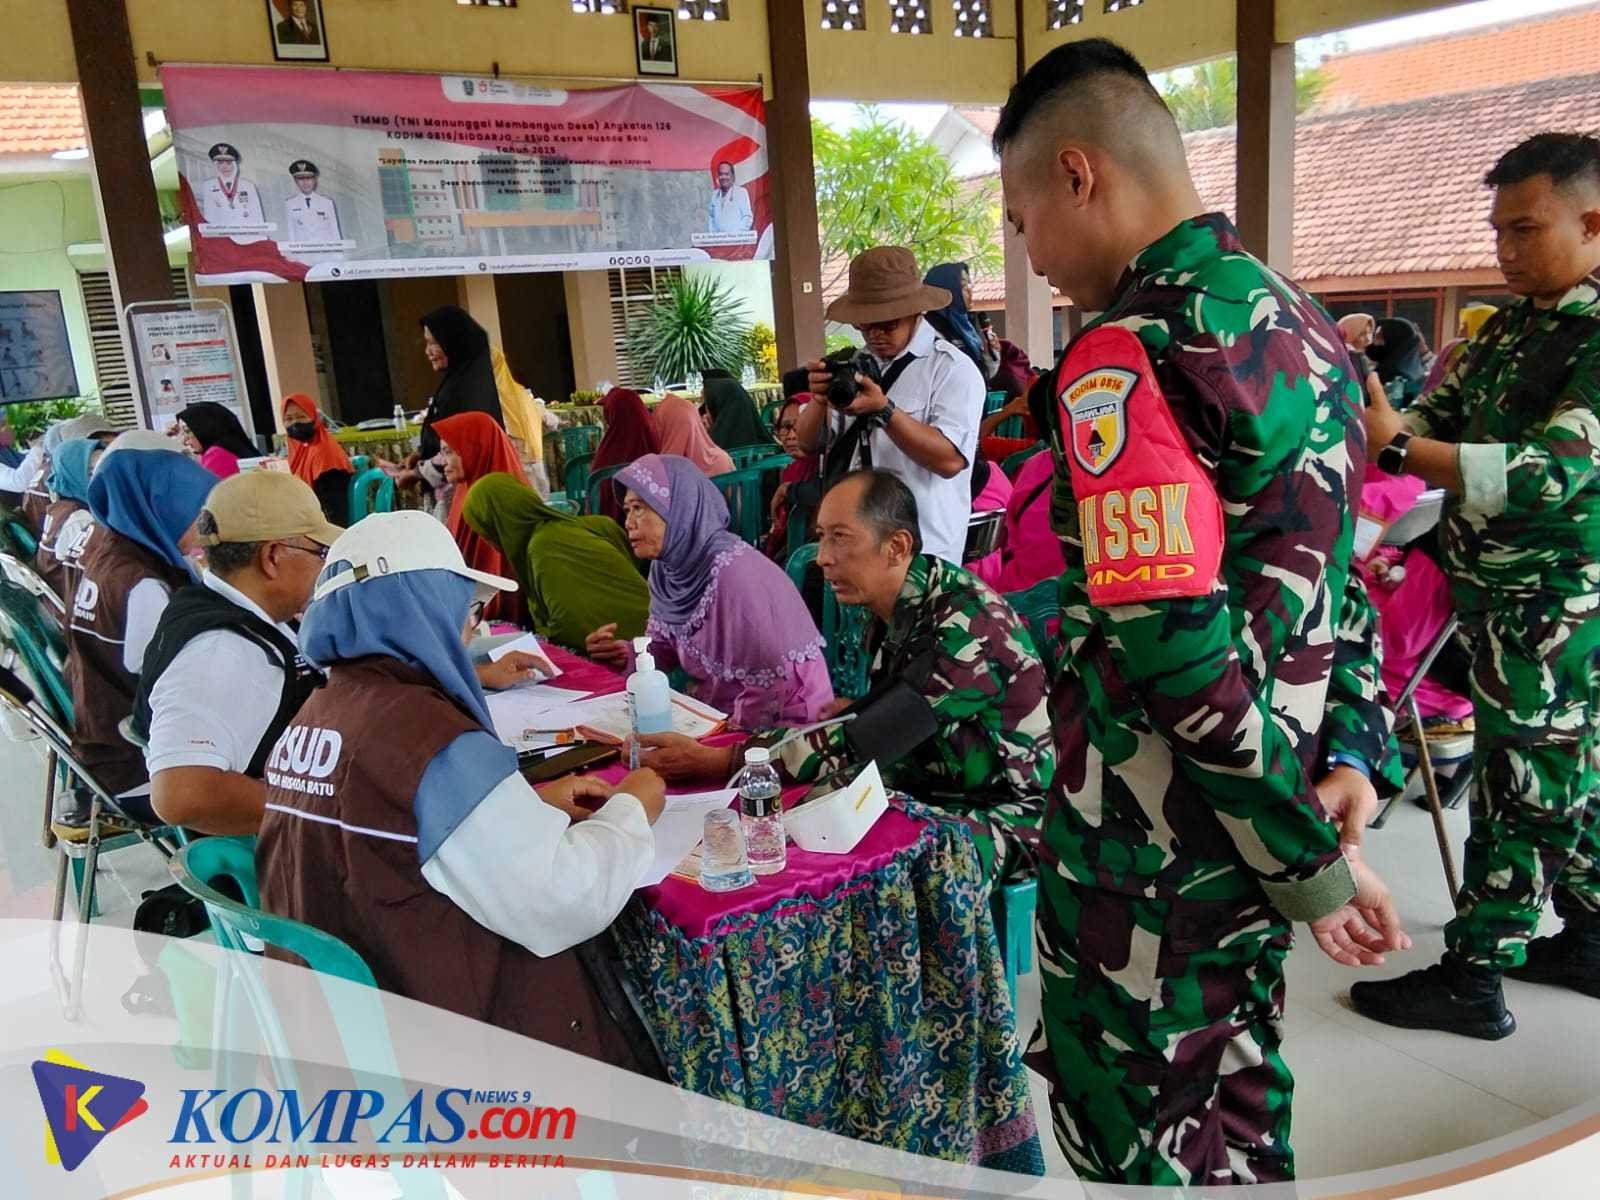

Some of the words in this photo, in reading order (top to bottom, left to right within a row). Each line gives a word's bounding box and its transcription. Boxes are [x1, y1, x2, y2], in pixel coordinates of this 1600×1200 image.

[353, 115, 390, 126] TMMD
[395, 115, 420, 127] (TNI
[424, 118, 492, 130] Manunggal
[495, 120, 564, 132] Membangun
[568, 121, 600, 132] Desa)
[604, 122, 653, 133] Angkatan
[387, 131, 424, 139] KODIM
[496, 146, 529, 154] Tahun
[1069, 378, 1097, 402] KODIM
[306, 780, 334, 797] BATU
